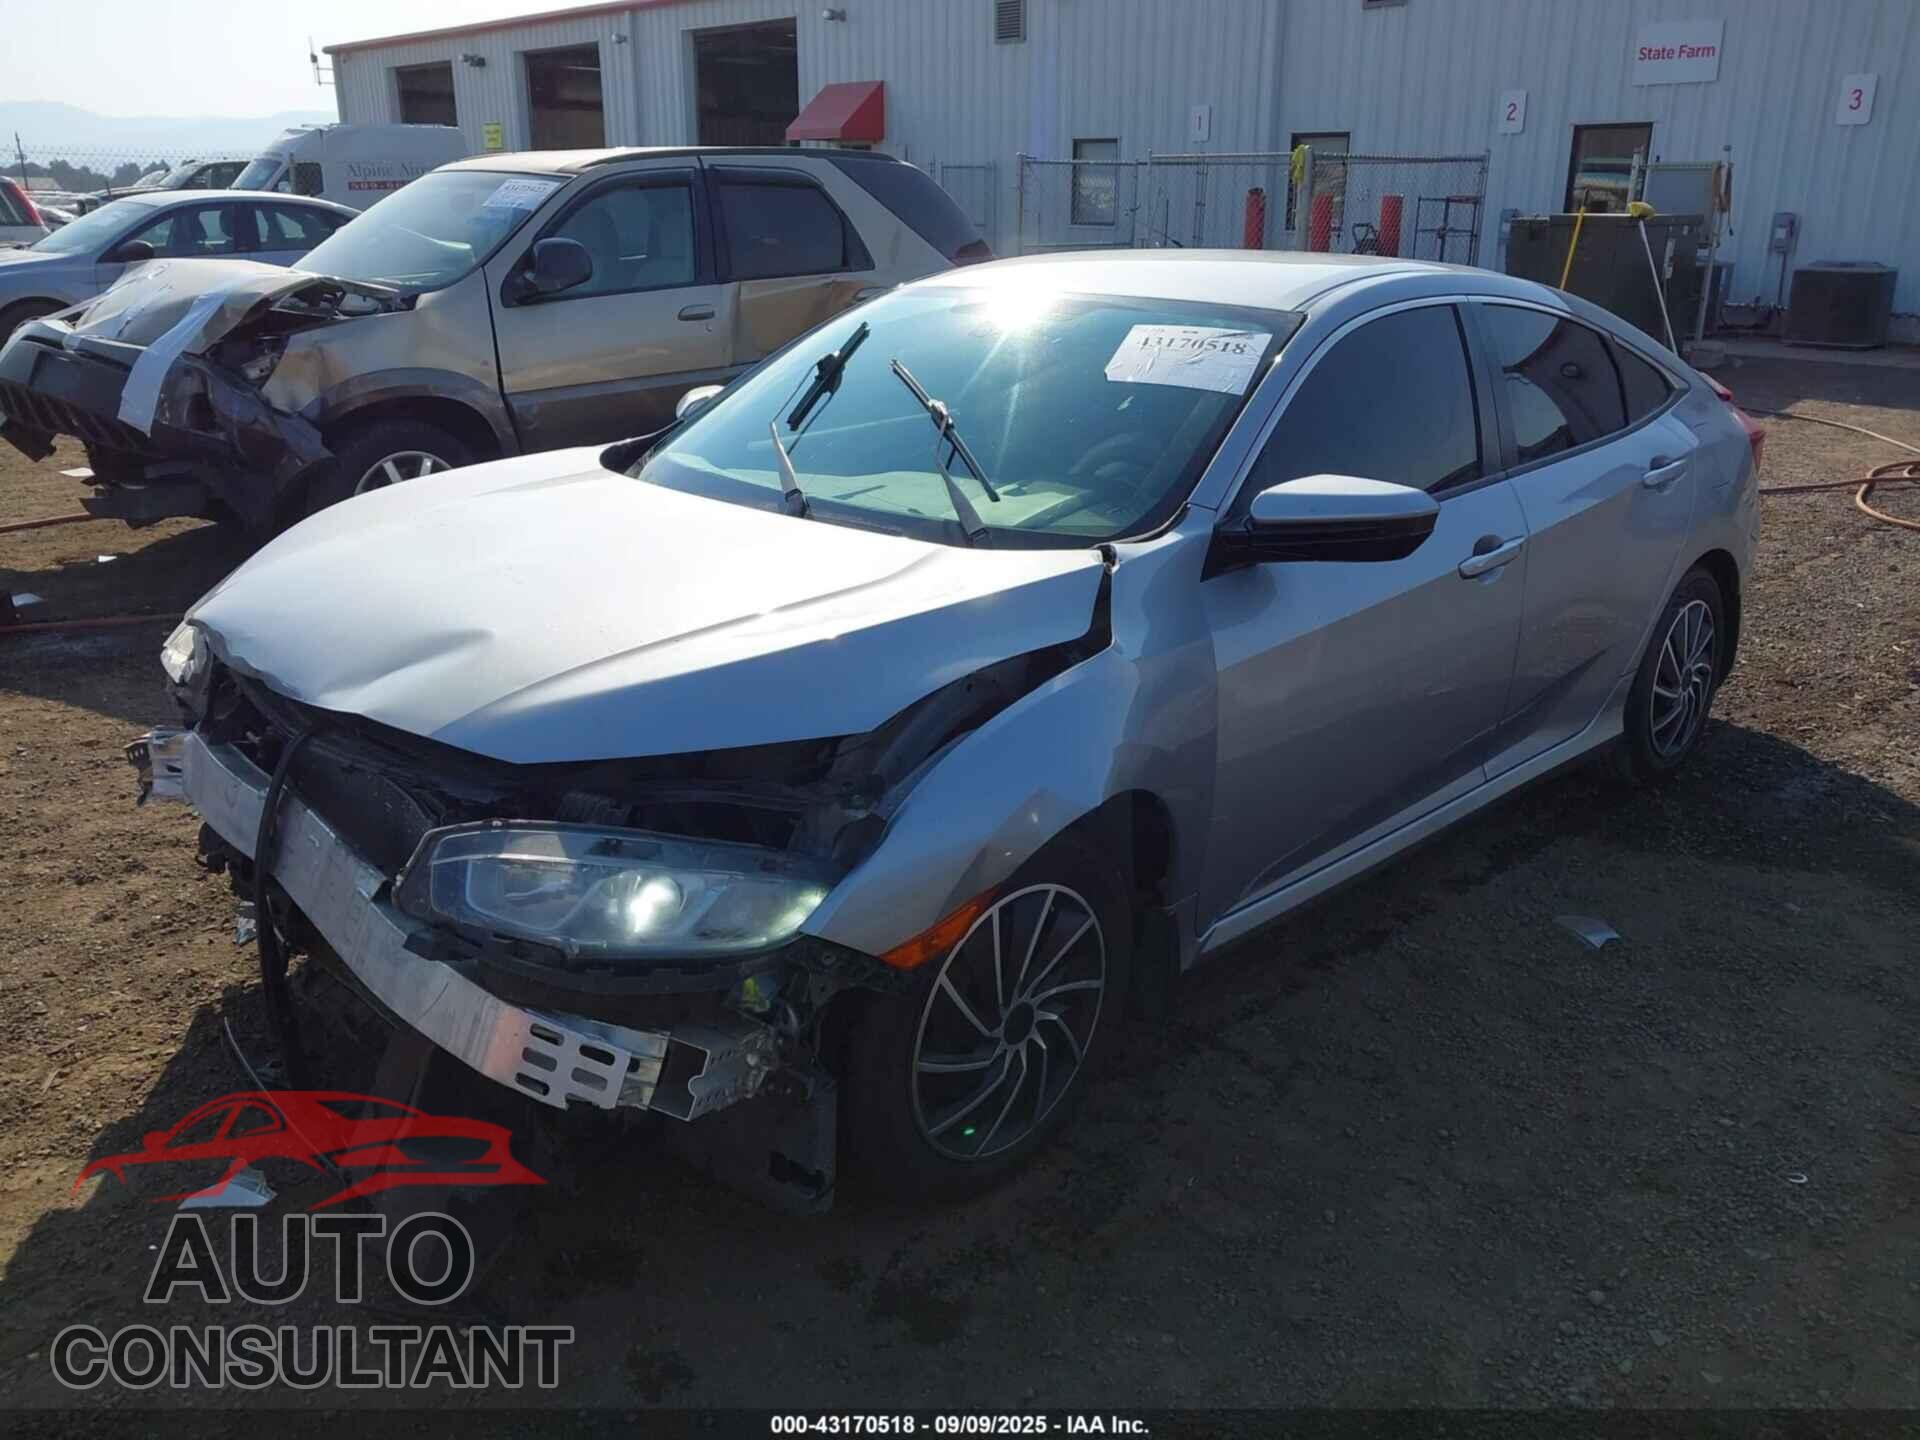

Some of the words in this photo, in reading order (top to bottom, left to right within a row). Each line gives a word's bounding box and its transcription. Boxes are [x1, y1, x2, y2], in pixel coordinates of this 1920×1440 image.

[1638, 45, 1675, 61] State
[1678, 44, 1716, 59] Farm
[1849, 88, 1863, 110] 3
[1506, 102, 1517, 121] 2
[1137, 335, 1248, 355] 43170518
